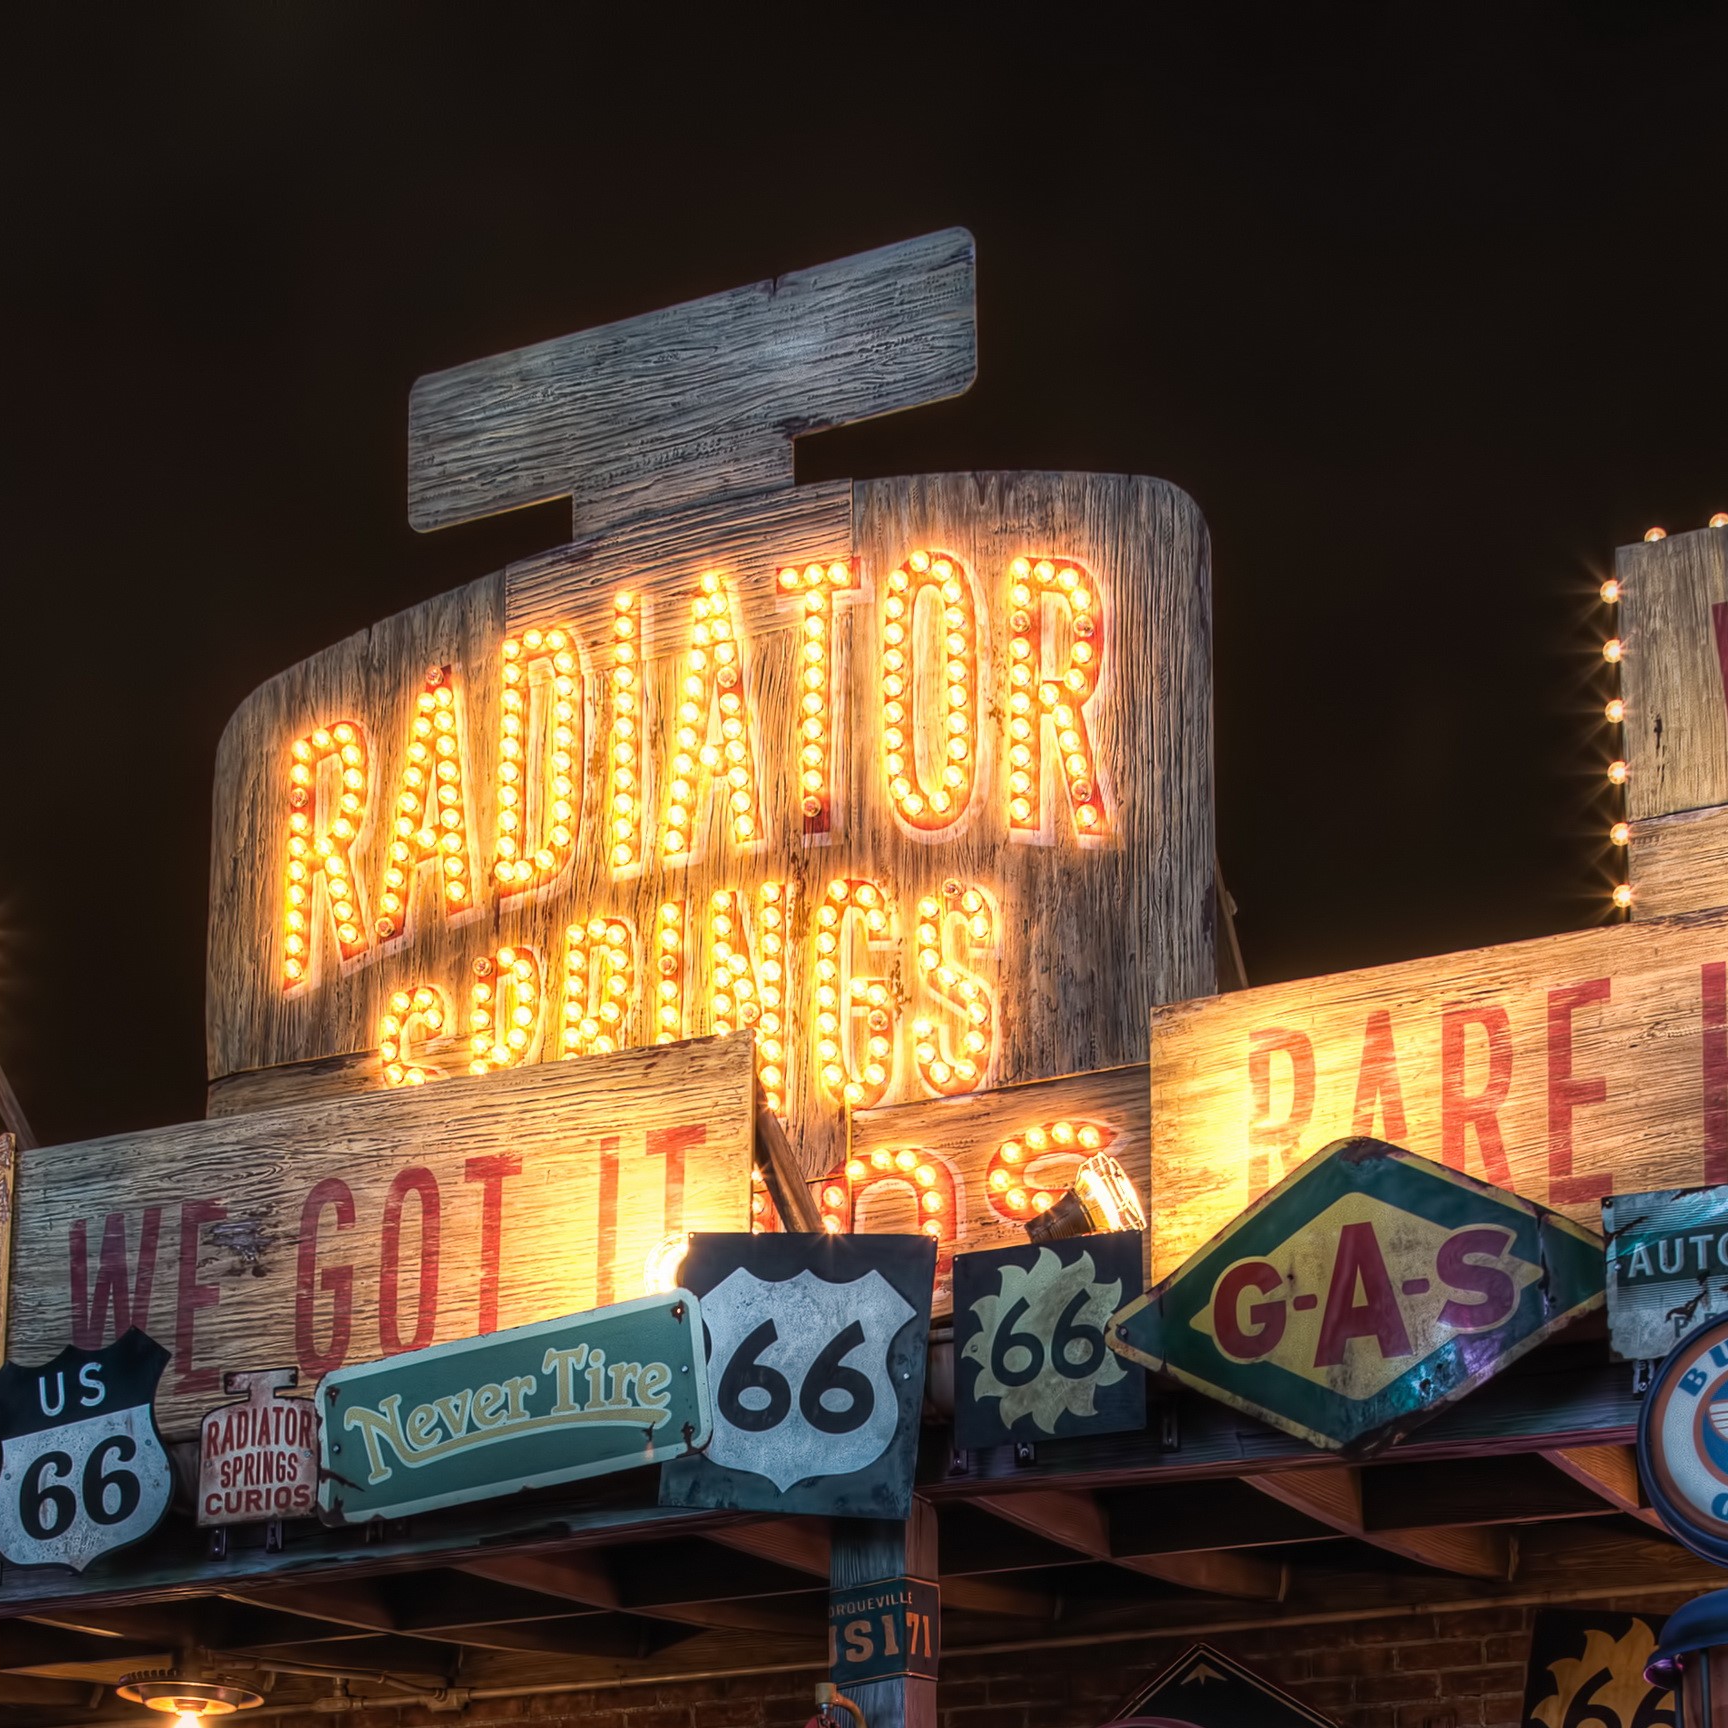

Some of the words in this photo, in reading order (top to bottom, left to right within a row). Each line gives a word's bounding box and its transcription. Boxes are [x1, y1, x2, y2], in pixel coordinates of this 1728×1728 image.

[278, 545, 1129, 1000] RADIATOR
[68, 1201, 228, 1395] WE
[294, 1150, 526, 1380] GOT
[1212, 1220, 1517, 1370] G-A-S
[37, 1360, 107, 1418] US
[717, 1317, 875, 1434] 66
[990, 1296, 1106, 1387] 66
[206, 1404, 313, 1459] RADIATOR
[343, 1374, 537, 1487] Never
[541, 1342, 673, 1416] Tire
[18, 1433, 141, 1541] 66
[204, 1482, 312, 1518] CURIOS
[220, 1449, 300, 1489] SPRINGS
